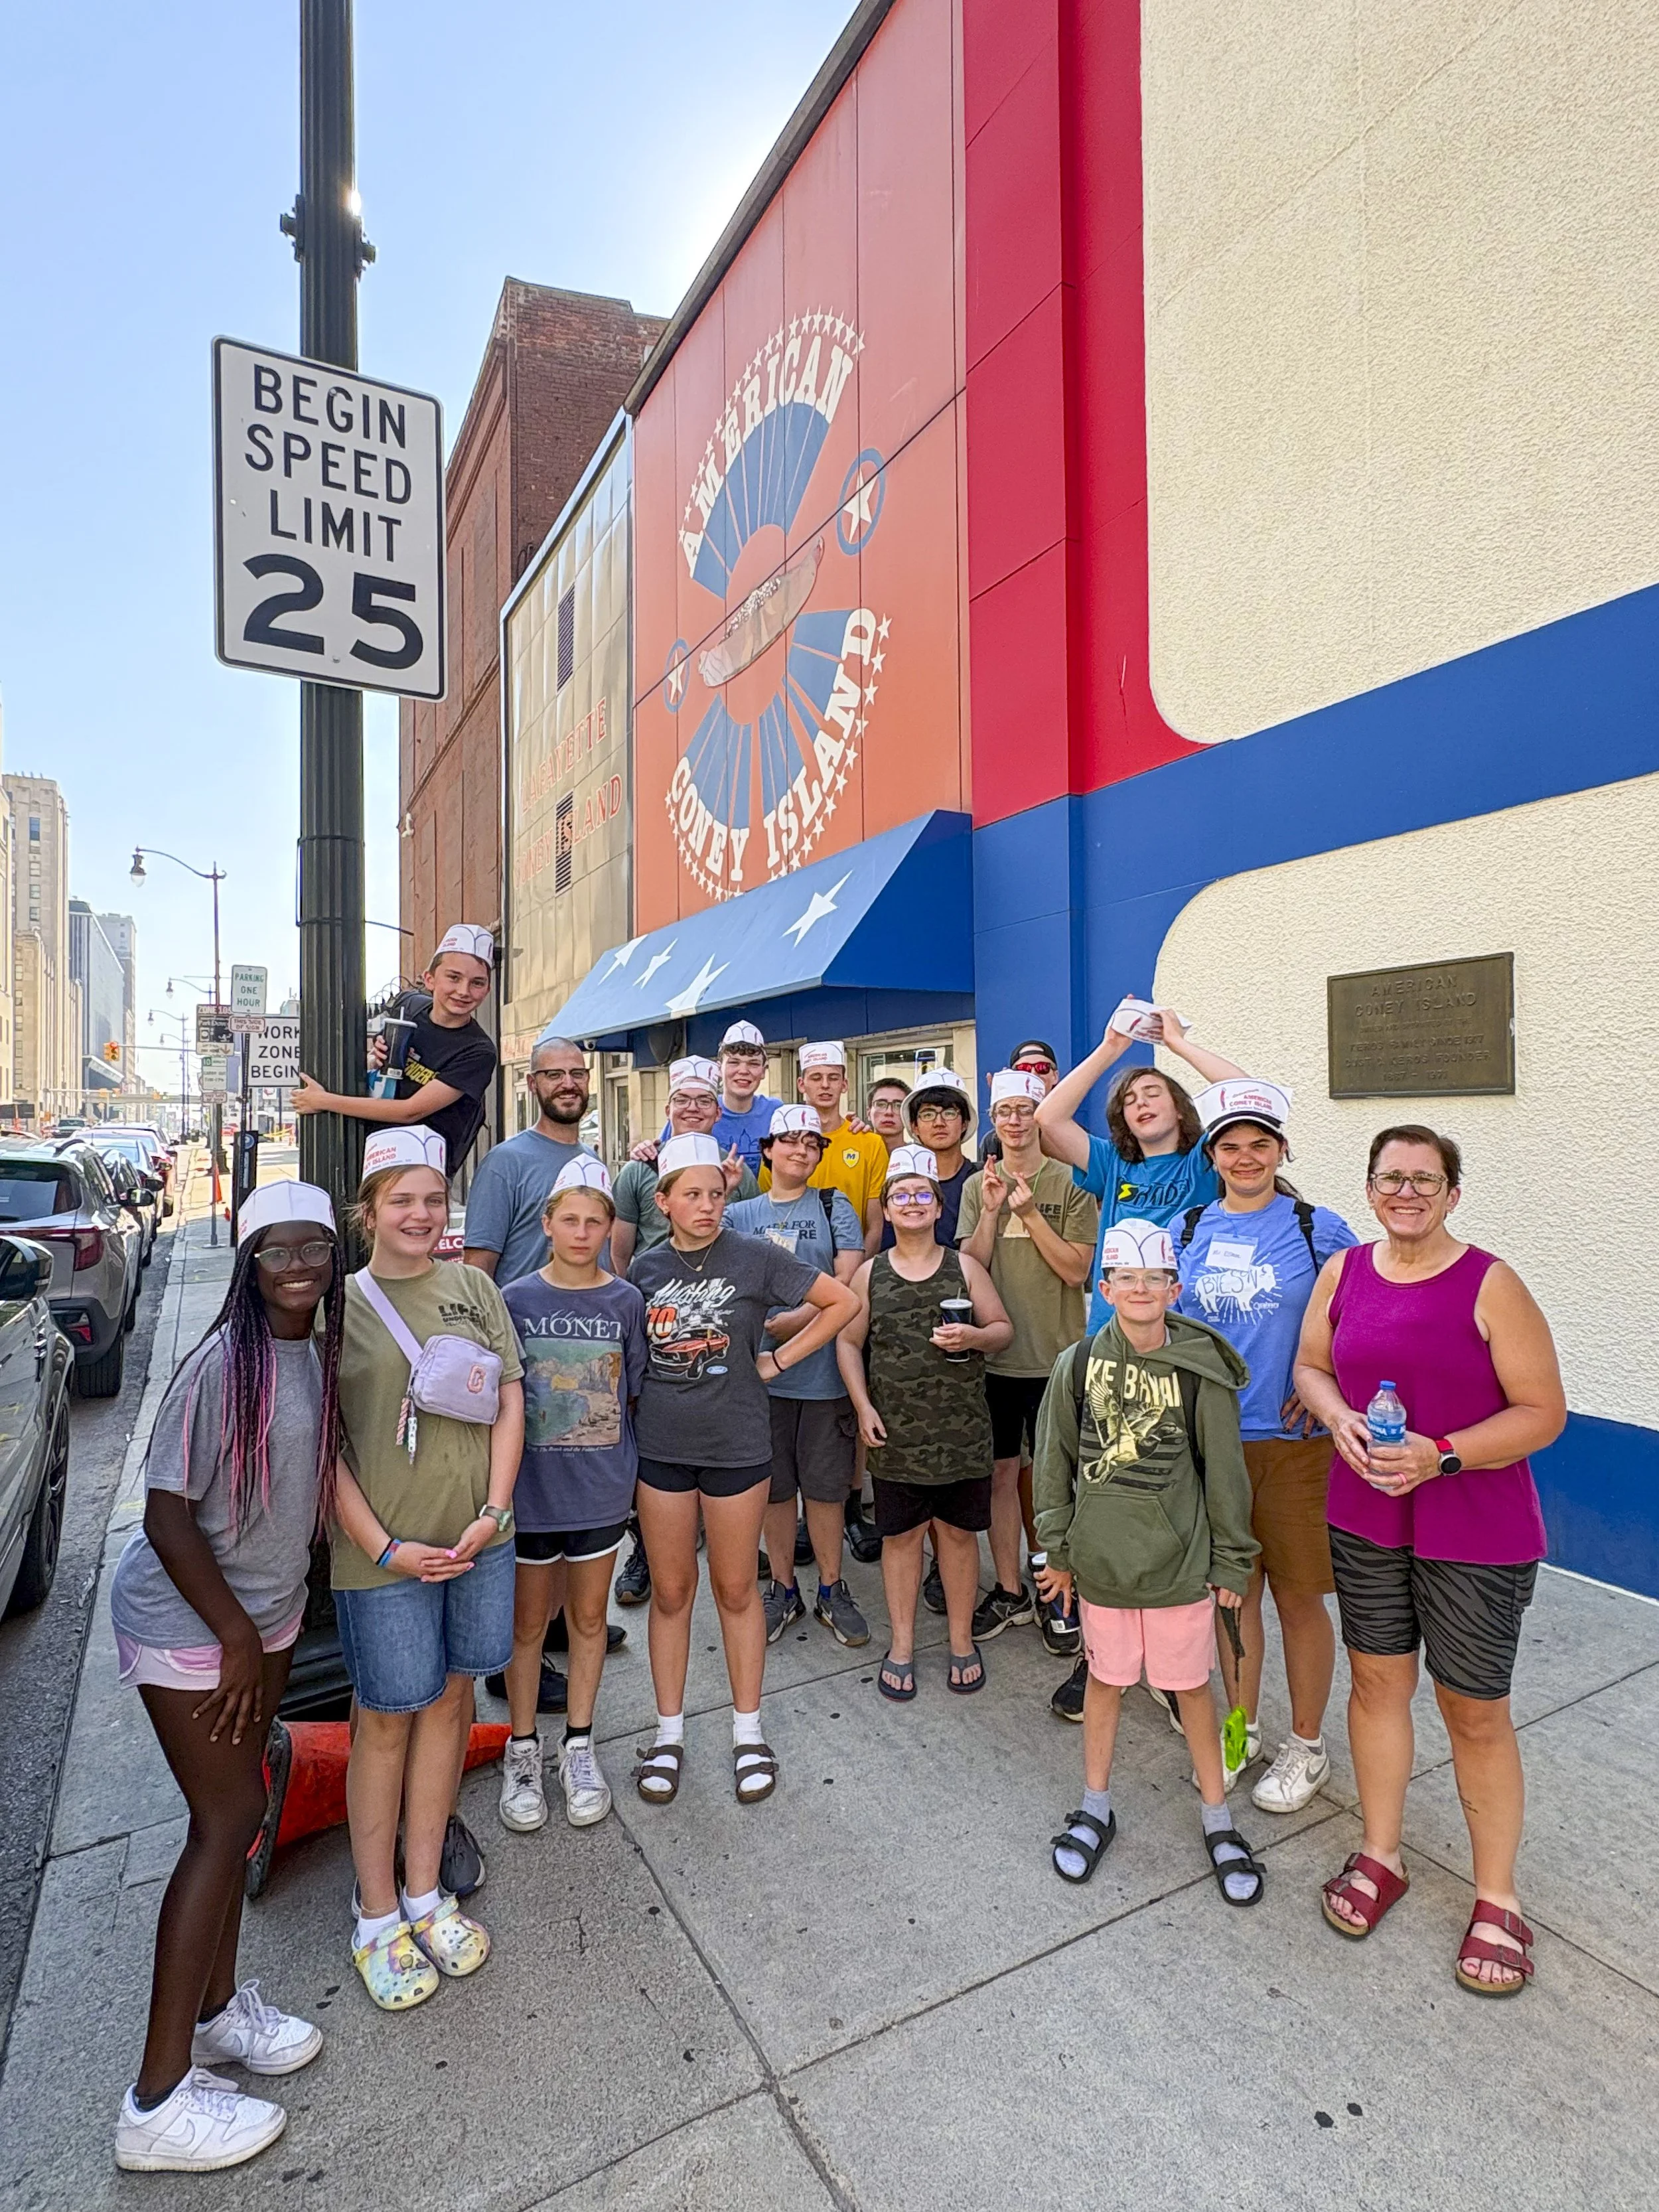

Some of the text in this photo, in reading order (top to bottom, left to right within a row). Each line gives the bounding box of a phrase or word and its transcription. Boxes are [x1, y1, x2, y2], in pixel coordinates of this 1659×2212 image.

[253, 364, 405, 449] BEGIN
[245, 423, 411, 504] SPEED
[679, 334, 853, 579] AMERICAN
[270, 489, 401, 563] LIMIT
[243, 553, 423, 670] 25
[520, 697, 607, 817] LAFAYETTE
[671, 607, 877, 881] CONEY ISLAND
[514, 774, 622, 890] CONEY ISLAND
[235, 973, 264, 982] PARKING
[241, 986, 257, 995] ONE
[1371, 975, 1458, 997] AMERICAN
[237, 998, 260, 1007] HOUR
[1354, 992, 1477, 1017] CONEY ISLAND
[258, 1046, 300, 1059] ZONE
[791, 1220, 816, 1229] FOR
[646, 1278, 736, 1308] Mustang
[523, 1317, 621, 1340] MONET
